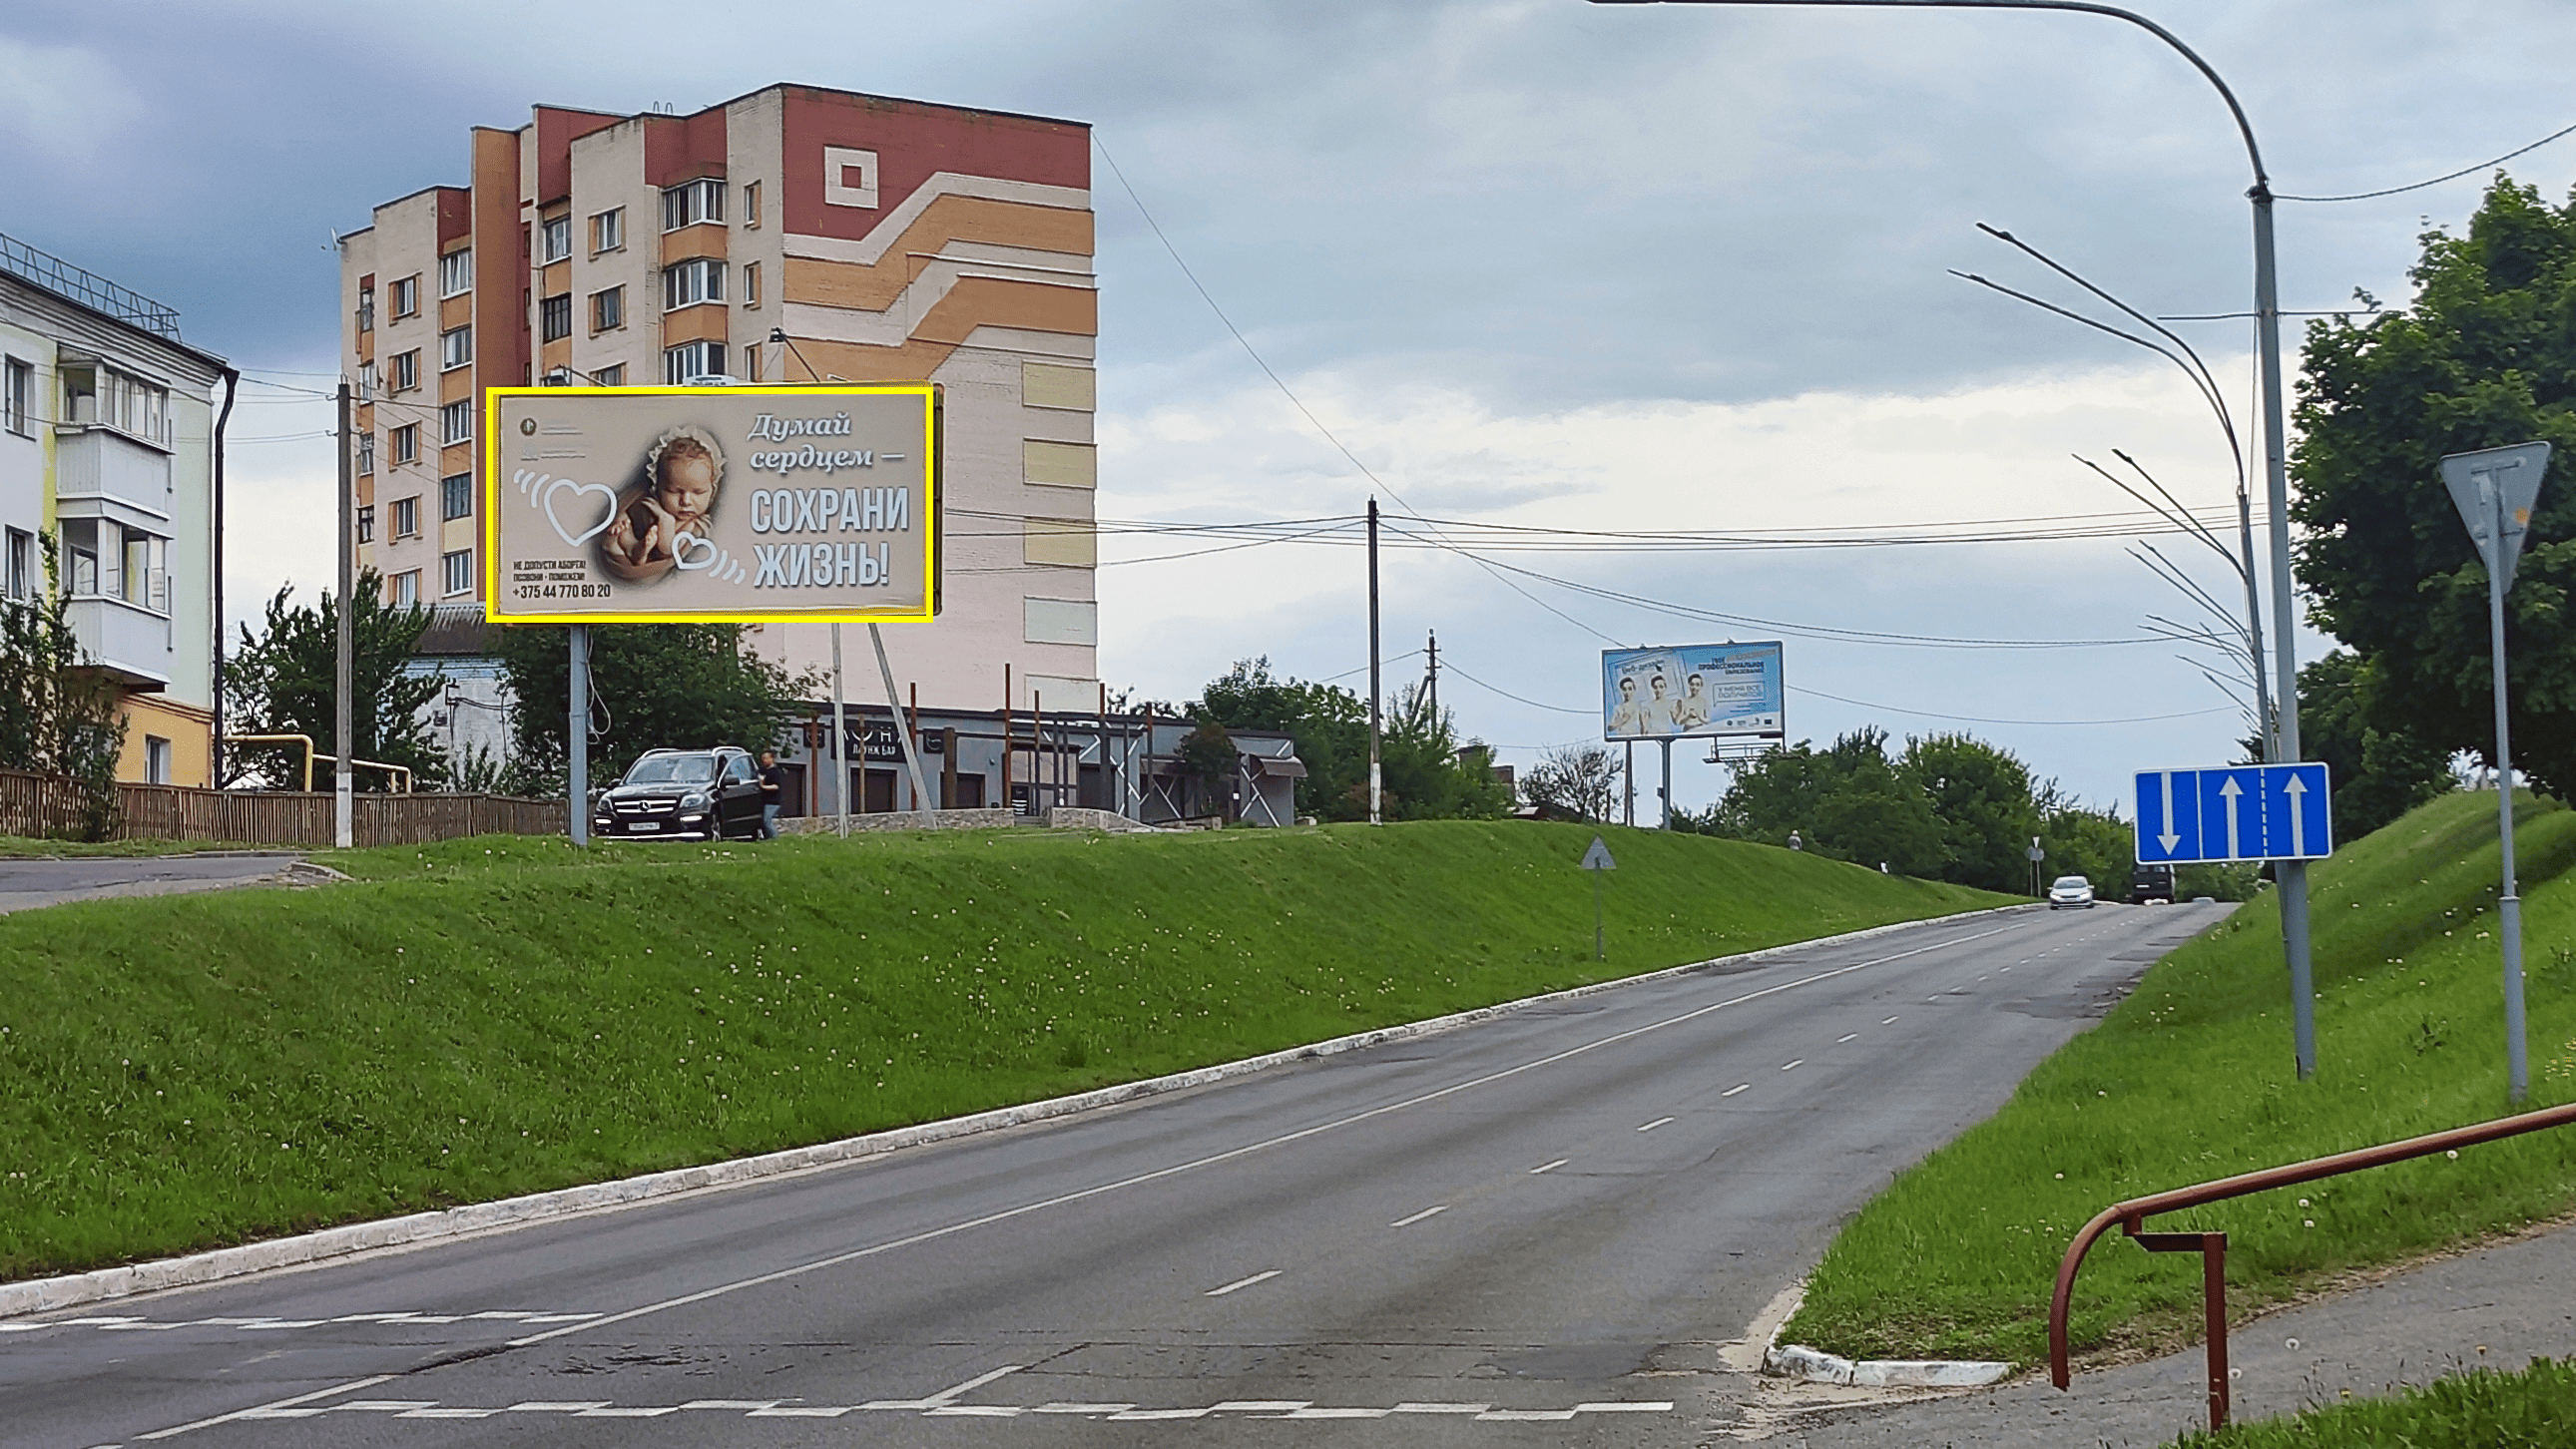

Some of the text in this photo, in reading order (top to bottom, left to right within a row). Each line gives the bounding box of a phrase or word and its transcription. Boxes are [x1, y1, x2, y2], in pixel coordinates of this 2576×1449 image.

[747, 412, 851, 442] Думай
[750, 444, 873, 474] сердцем
[751, 487, 909, 532] СОХРАНИ
[753, 542, 889, 587] ЖИЗНЬ!
[513, 583, 611, 599] +375 44 770 80 20
[881, 744, 896, 755] БАР
